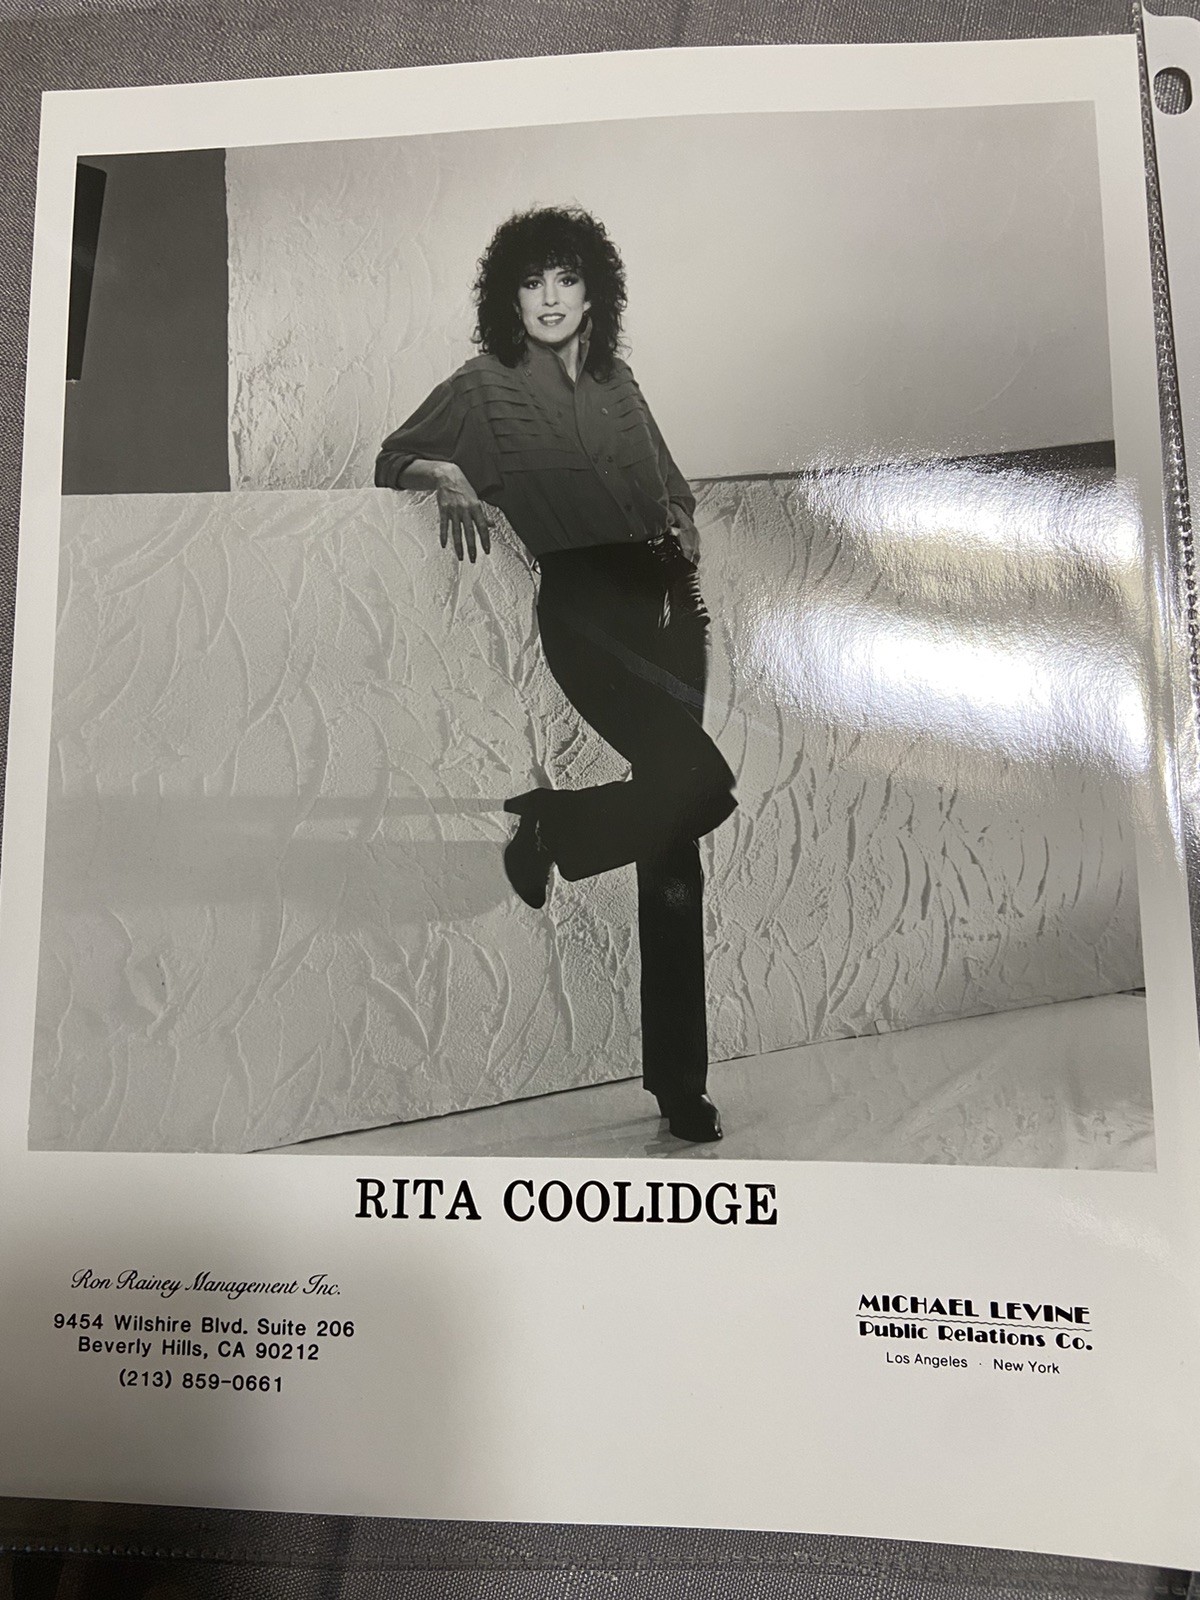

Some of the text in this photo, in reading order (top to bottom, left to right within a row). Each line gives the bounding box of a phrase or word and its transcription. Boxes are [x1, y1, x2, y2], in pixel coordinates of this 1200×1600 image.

[354, 1177, 778, 1226] RITA COOLIDGE
[70, 1268, 341, 1301] Ron Rainey Management Inc.
[858, 1293, 1091, 1325] MICHAEL LEVINE
[53, 1312, 355, 1338] 9454 Wilshire Blvd. Suite 206
[858, 1320, 1094, 1351] Public Relations Co.
[78, 1335, 320, 1361] Beverly Hills, CA 90212
[886, 1351, 1061, 1375] Los Angeles New York
[119, 1368, 282, 1393] (213) 859-0661
